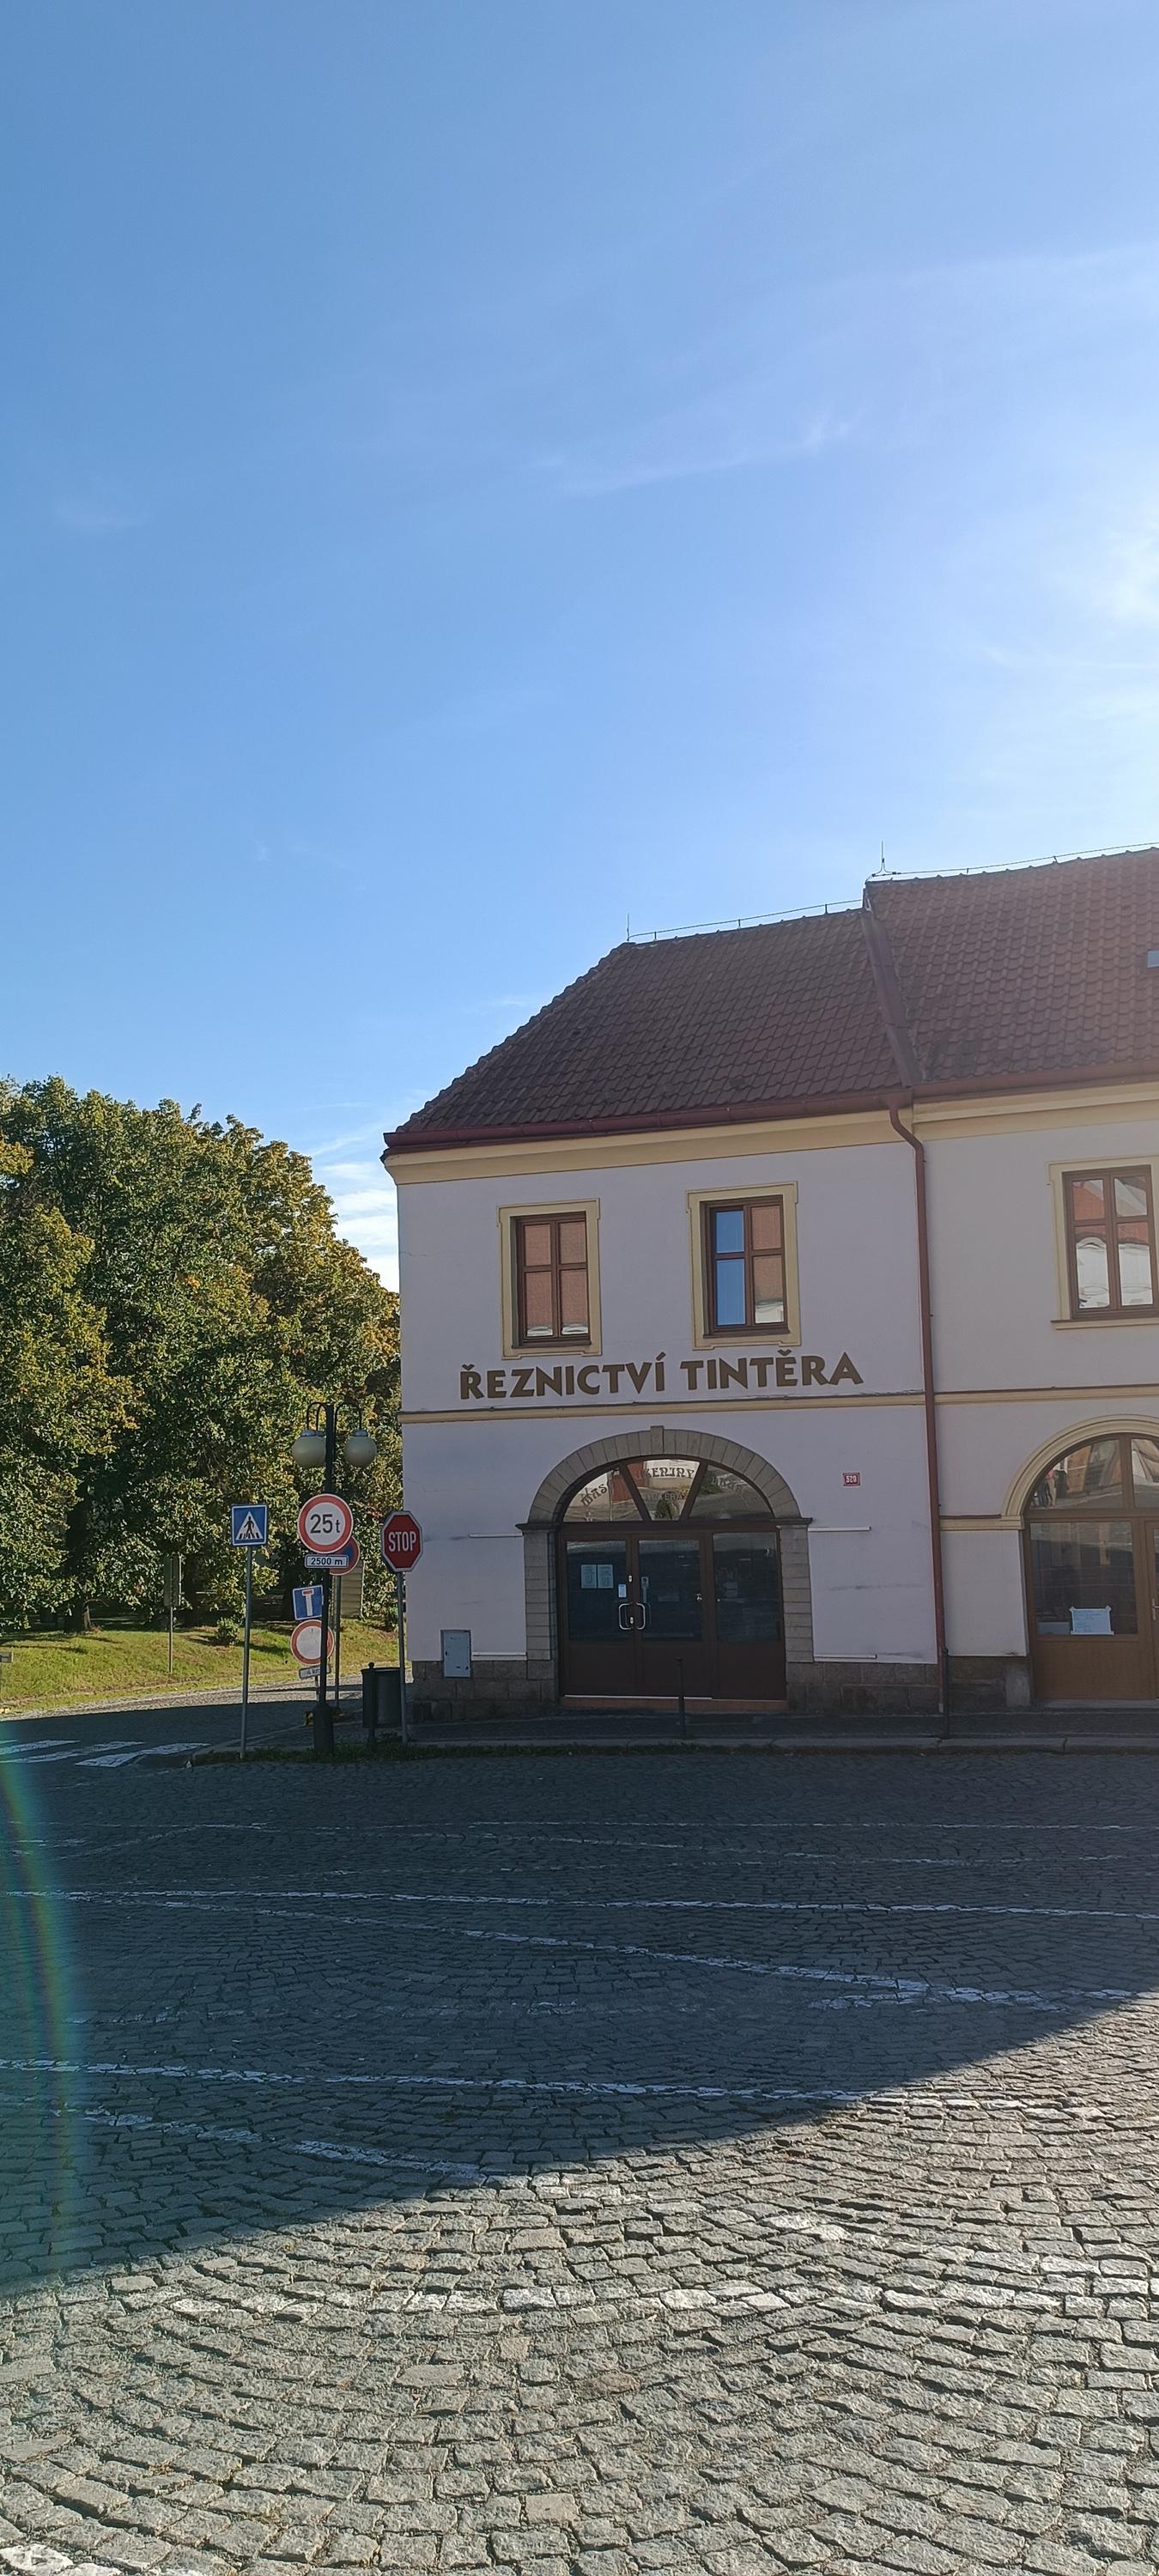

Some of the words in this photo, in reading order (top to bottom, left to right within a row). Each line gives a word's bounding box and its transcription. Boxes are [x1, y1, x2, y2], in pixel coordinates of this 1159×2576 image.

[459, 1352, 666, 1400] ŘEZNICTVÍ
[679, 1349, 864, 1391] TINTĚRA
[388, 1531, 417, 1552] STOP
[311, 1557, 332, 1565] 2500
